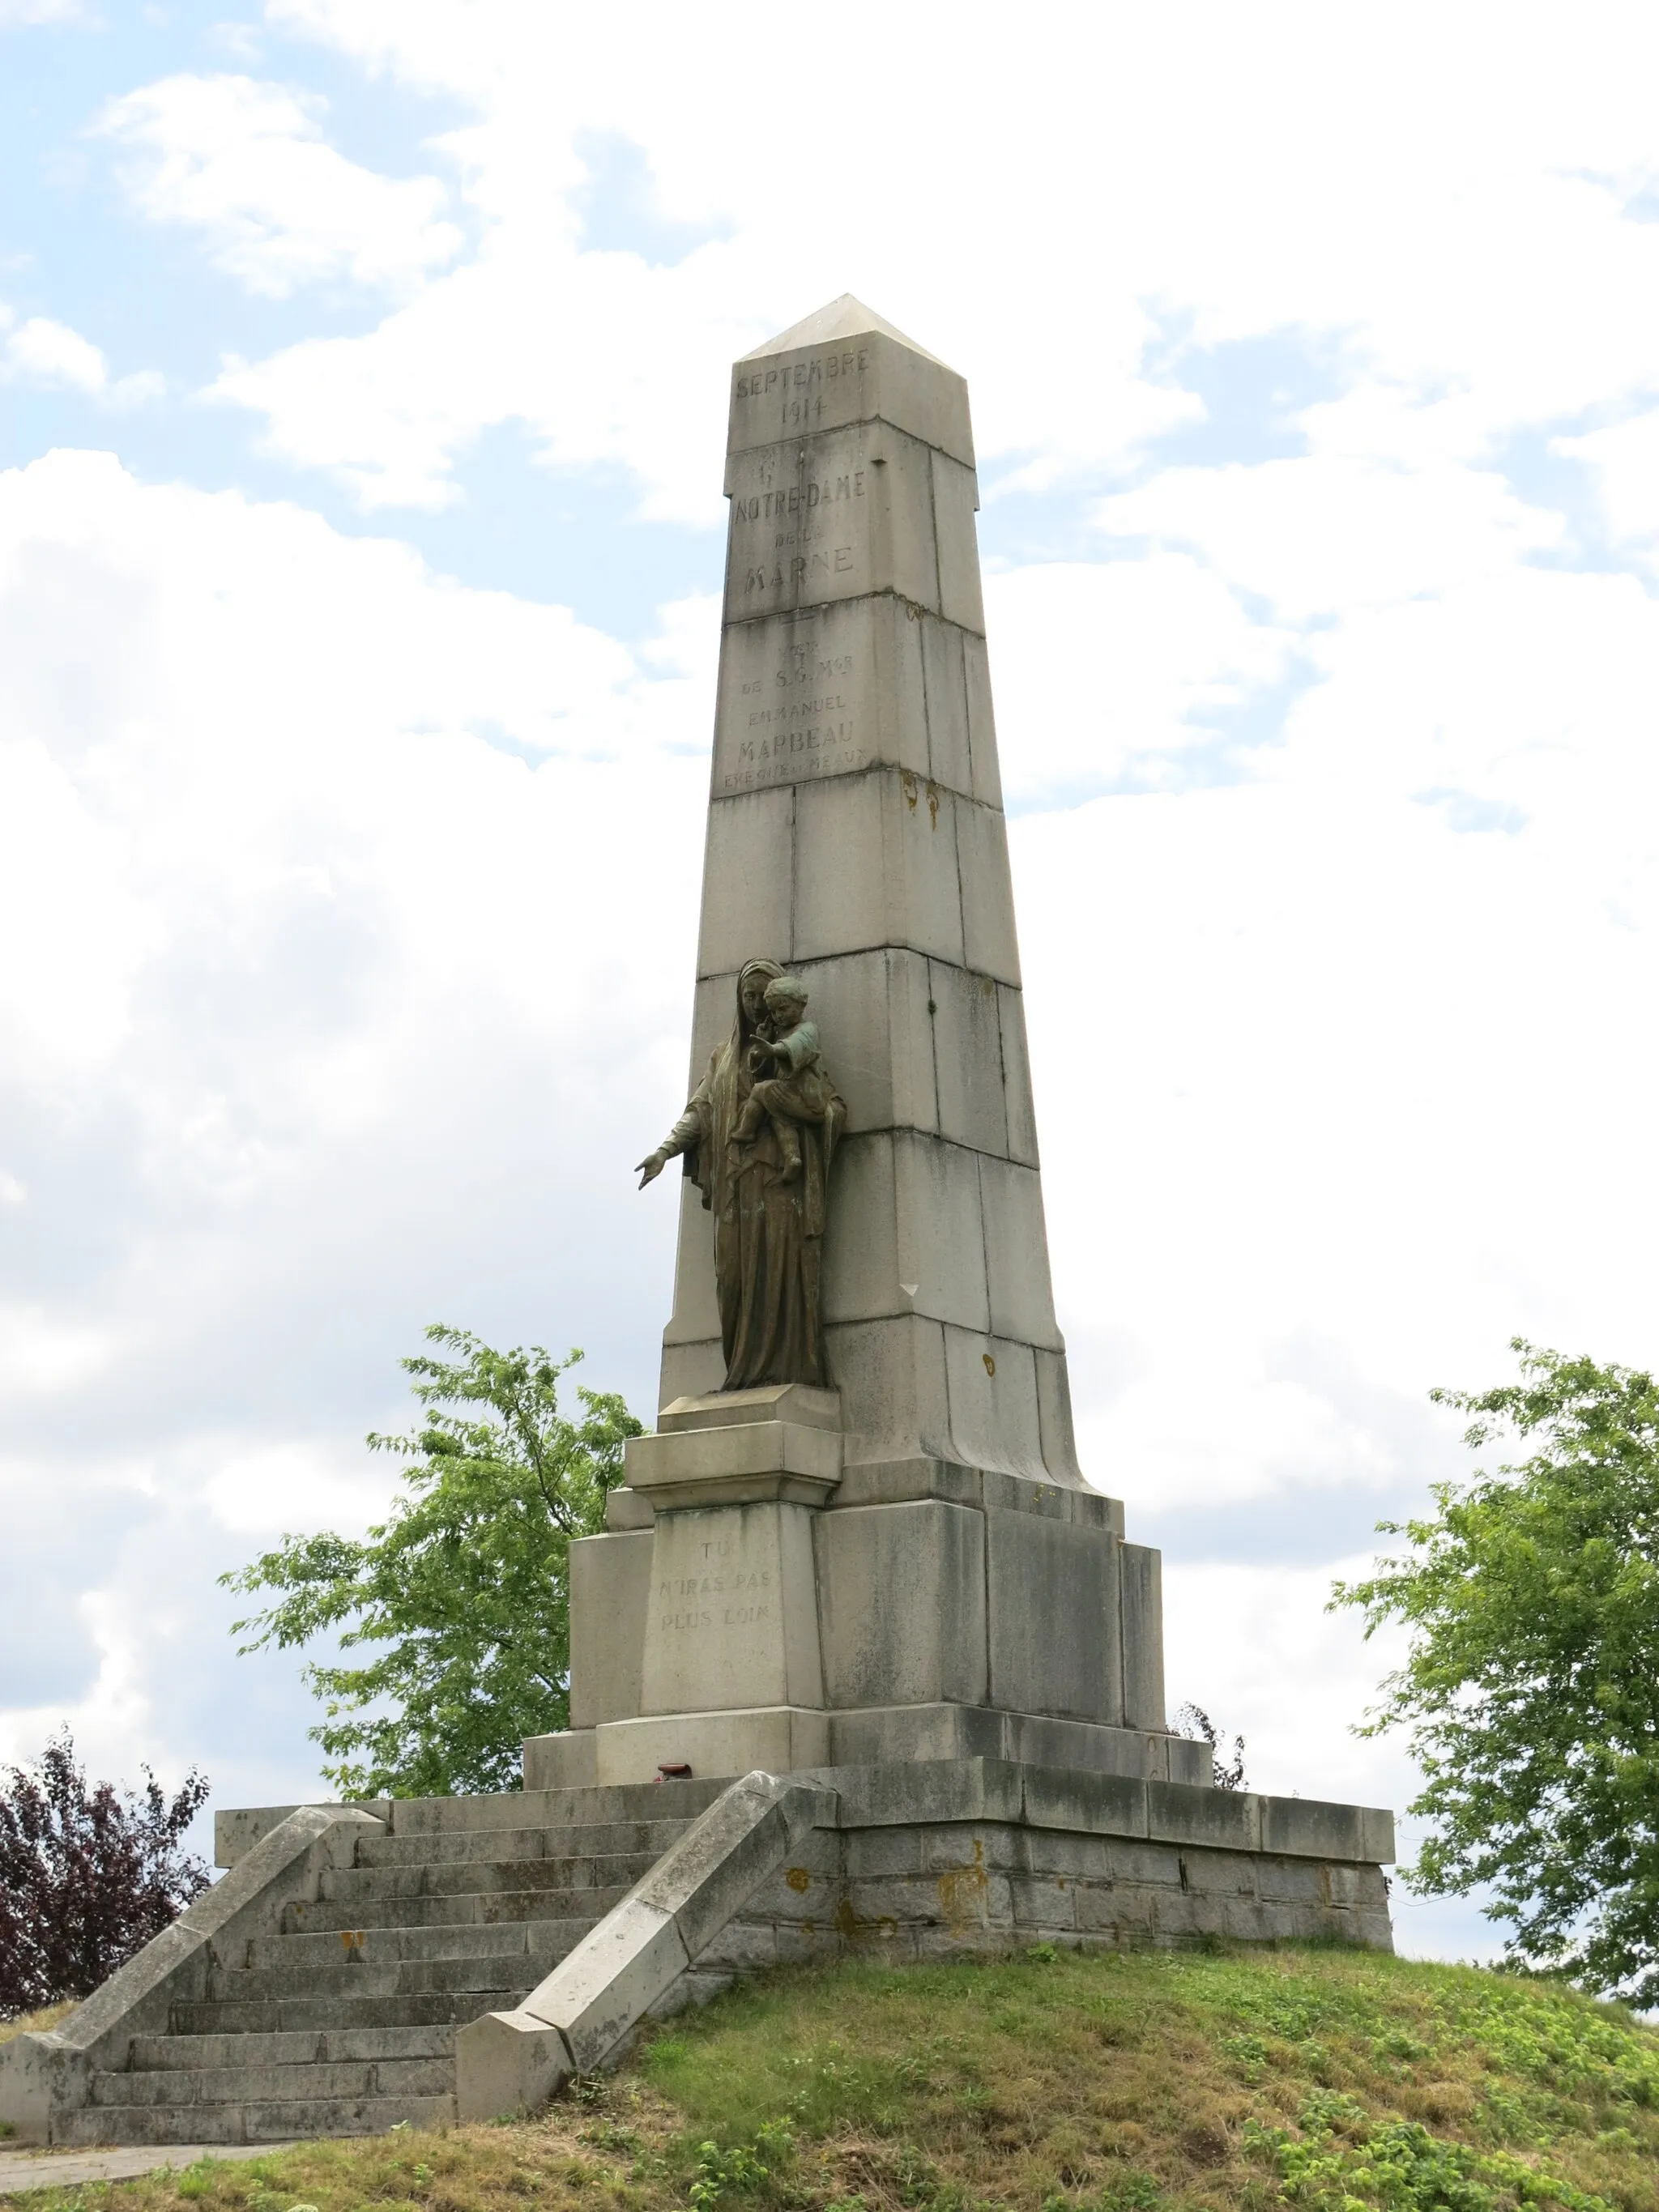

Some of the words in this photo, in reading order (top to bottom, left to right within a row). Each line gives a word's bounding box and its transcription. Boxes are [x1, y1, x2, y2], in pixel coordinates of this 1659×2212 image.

[782, 395, 828, 427] 1914
[735, 471, 866, 525] NOTRE-DAME
[774, 531, 795, 548] DE
[744, 547, 854, 595] MARNE
[742, 680, 762, 695] DE
[748, 695, 846, 726] EMMANUEL
[809, 748, 867, 770] MEAUX
[700, 1541, 728, 1558] TU
[736, 1571, 770, 1590] PAS
[661, 1610, 712, 1631] PLUS
[723, 1605, 770, 1625] LOIN
